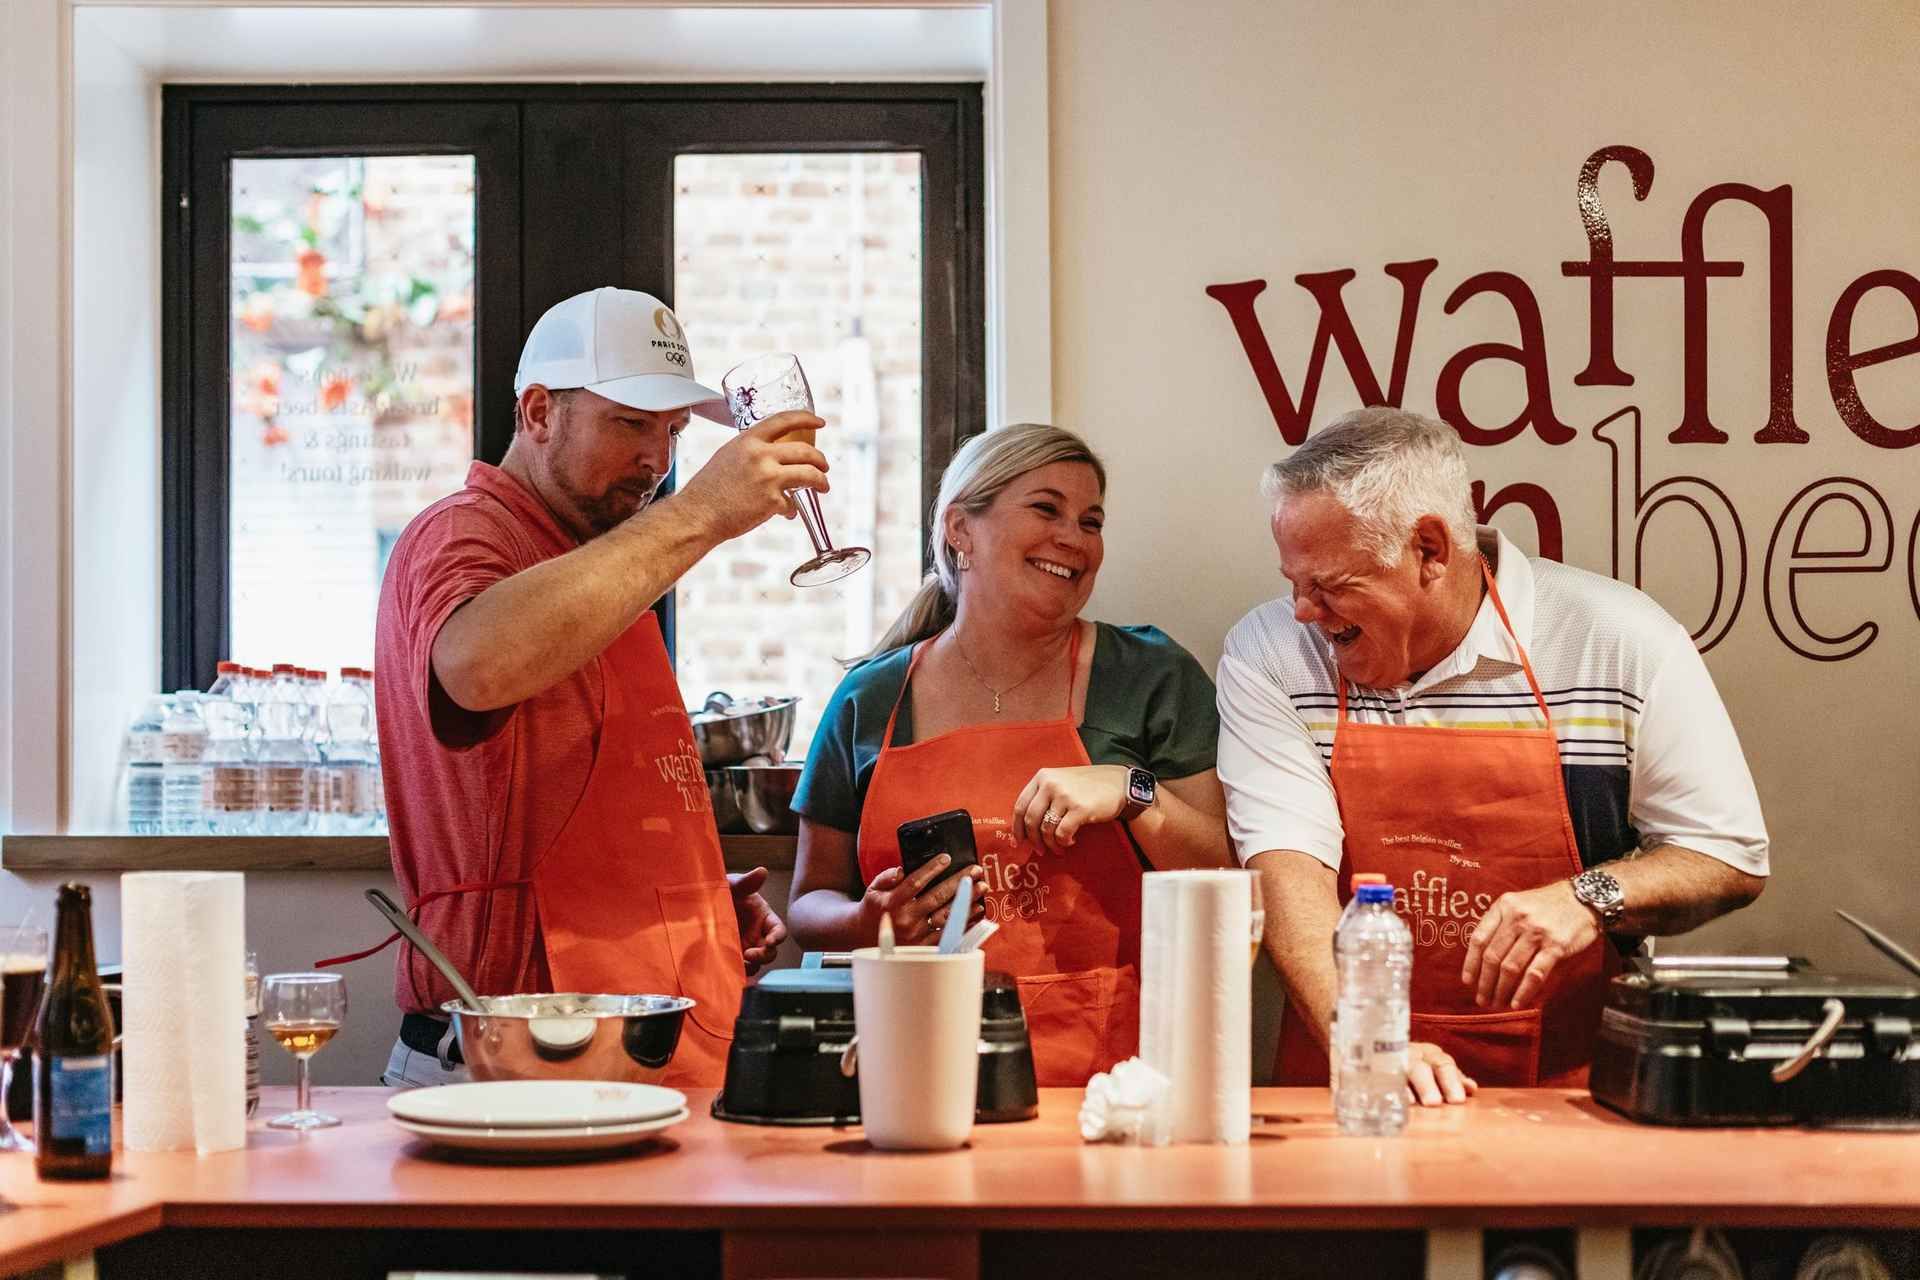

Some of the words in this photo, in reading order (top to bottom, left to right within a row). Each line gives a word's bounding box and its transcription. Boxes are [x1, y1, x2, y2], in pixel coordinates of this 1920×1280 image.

[651, 340, 676, 349] PARIS
[1381, 837, 1394, 847] The
[1395, 834, 1410, 843] best
[1411, 833, 1436, 845] Belgian
[1449, 854, 1461, 865] By
